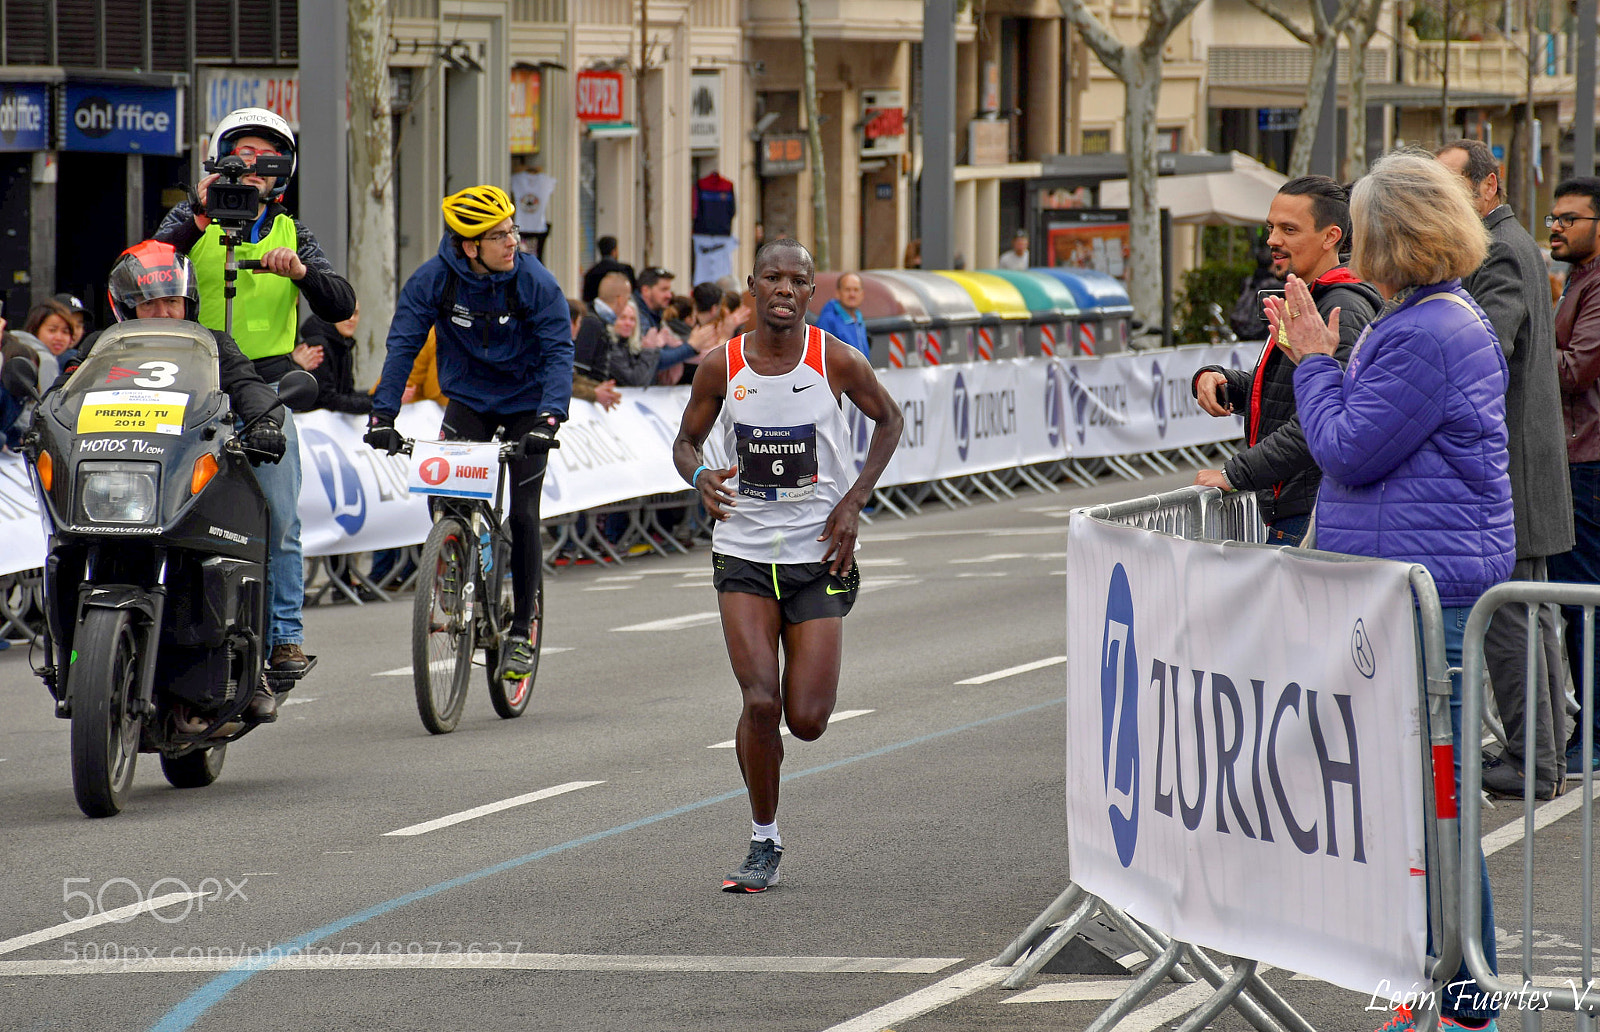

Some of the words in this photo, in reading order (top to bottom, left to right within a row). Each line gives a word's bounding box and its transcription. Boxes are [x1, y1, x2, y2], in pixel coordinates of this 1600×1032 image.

[579, 77, 620, 115] SUPER
[239, 115, 267, 123] MOTOS
[137, 269, 173, 287] MOTOS
[133, 361, 180, 389] 3
[974, 389, 1017, 439] ZURICH
[80, 438, 128, 452] MOTOS
[748, 442, 806, 454] MARITIM
[426, 461, 440, 481] 1
[455, 465, 489, 480] HOME
[771, 459, 784, 476] 6
[69, 525, 164, 536] MOTOTRAVELLING
[1149, 657, 1368, 865] ZURICH
